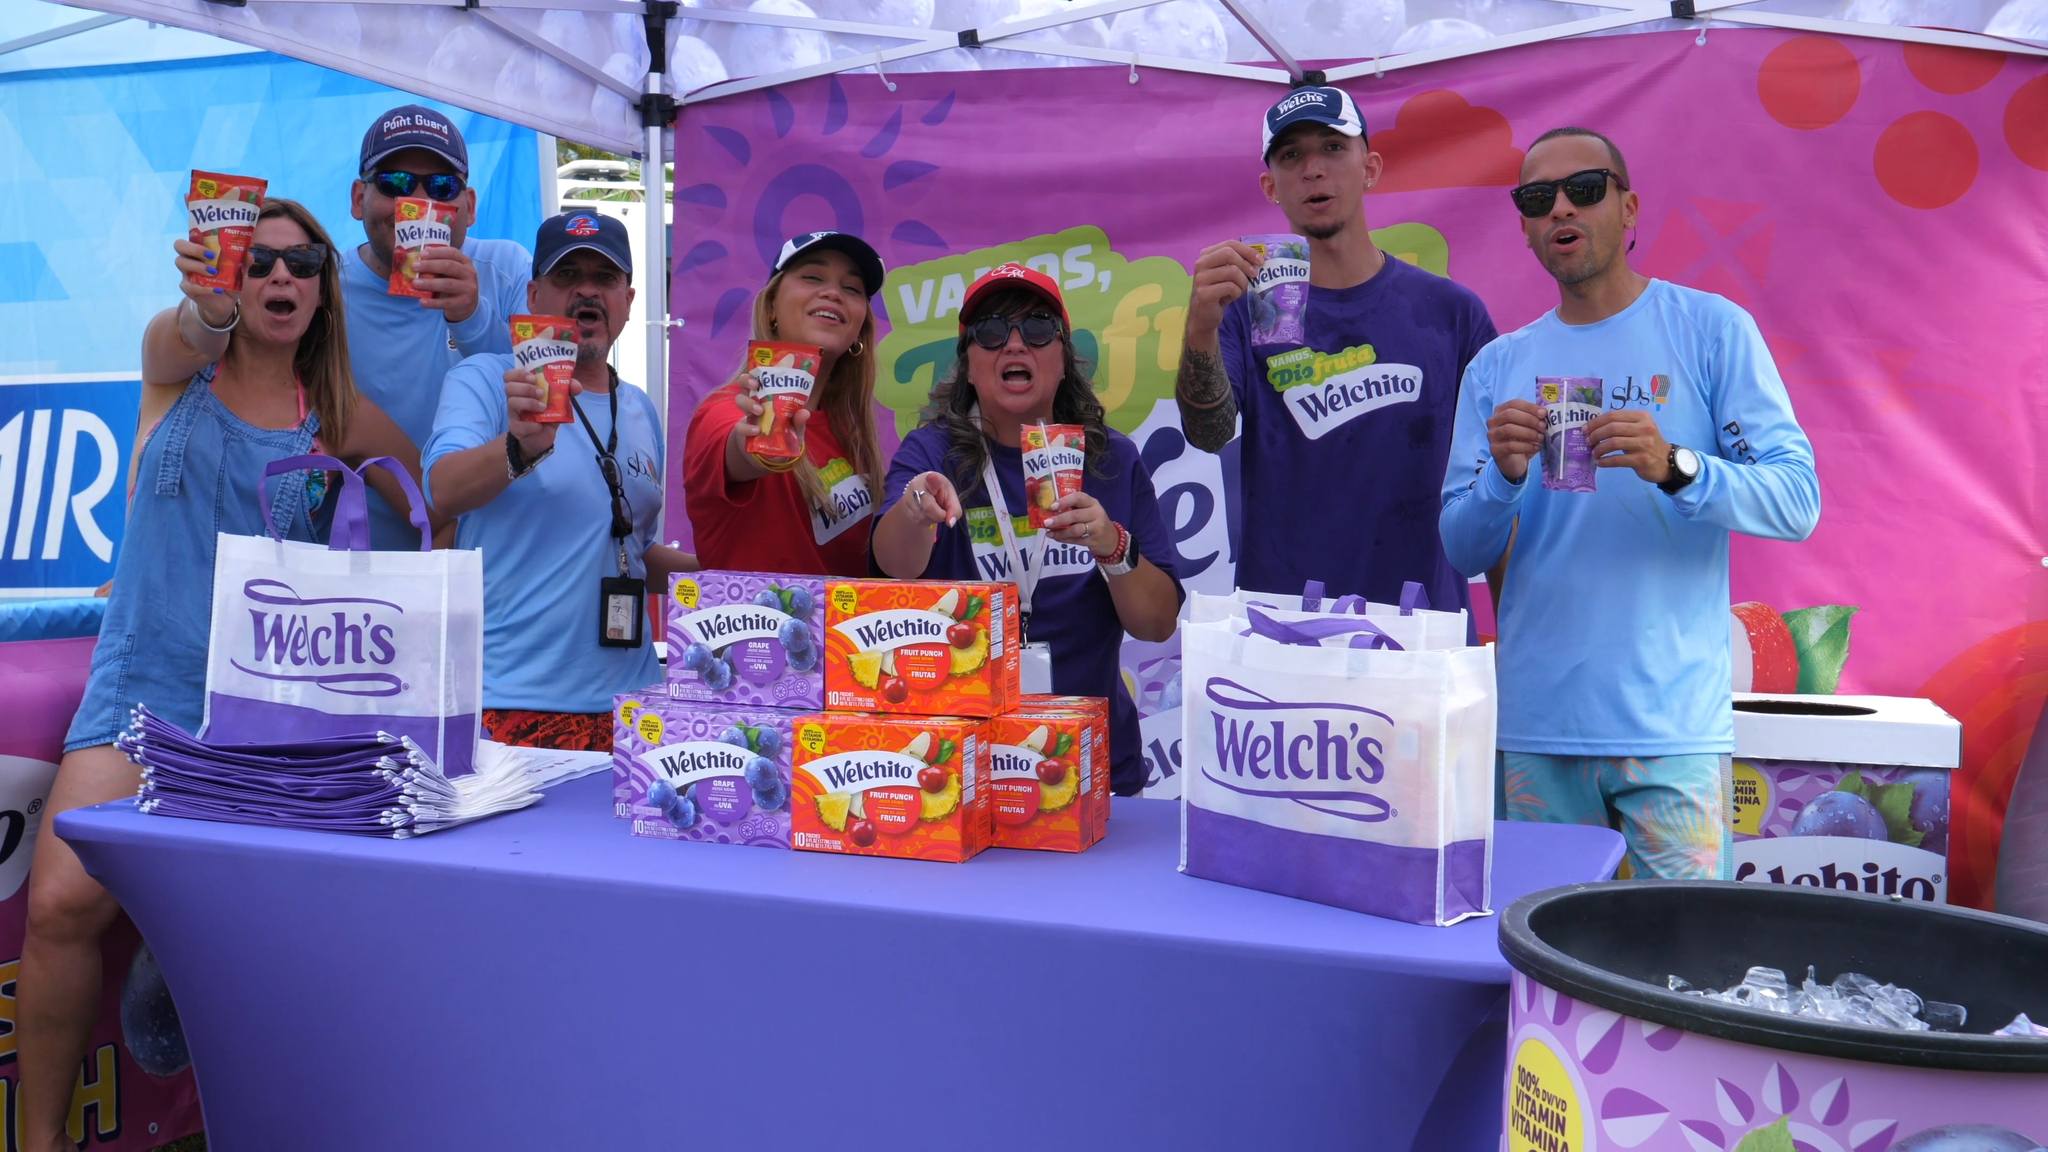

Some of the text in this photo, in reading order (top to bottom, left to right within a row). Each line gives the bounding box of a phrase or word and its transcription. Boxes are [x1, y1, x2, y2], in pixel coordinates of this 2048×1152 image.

[1278, 93, 1323, 114] Welch's
[383, 114, 448, 134] Point Guard
[899, 244, 1112, 325] VAOS,
[516, 345, 575, 368] Welchito
[1270, 351, 1313, 367] VAMOS,
[1296, 374, 1416, 423] Welchito
[1610, 376, 1650, 410] sbs
[683, 596, 689, 604] C
[842, 602, 848, 610] C
[696, 613, 778, 641] Welchito
[856, 618, 941, 648] Welchito
[248, 608, 396, 667] Welch's
[748, 641, 769, 649] GRAPE
[911, 671, 936, 679] FRUTAS
[669, 683, 679, 697] 10
[828, 691, 839, 706] 10
[648, 732, 653, 740] C
[810, 742, 816, 750] C
[1210, 710, 1385, 784] Welch's
[660, 750, 743, 778] Welchito
[990, 754, 1031, 772] hito
[824, 760, 913, 789] Welchito
[890, 793, 913, 801] PUNCH
[1009, 785, 1032, 793] PUNCH
[616, 803, 625, 816] 10
[1000, 806, 1025, 814] FRUTAS
[634, 820, 643, 834] 10
[880, 815, 906, 823] FRUTAS
[794, 832, 805, 847] 10
[1517, 1064, 1541, 1099] 100%
[1516, 1085, 1567, 1137] VITAMIN
